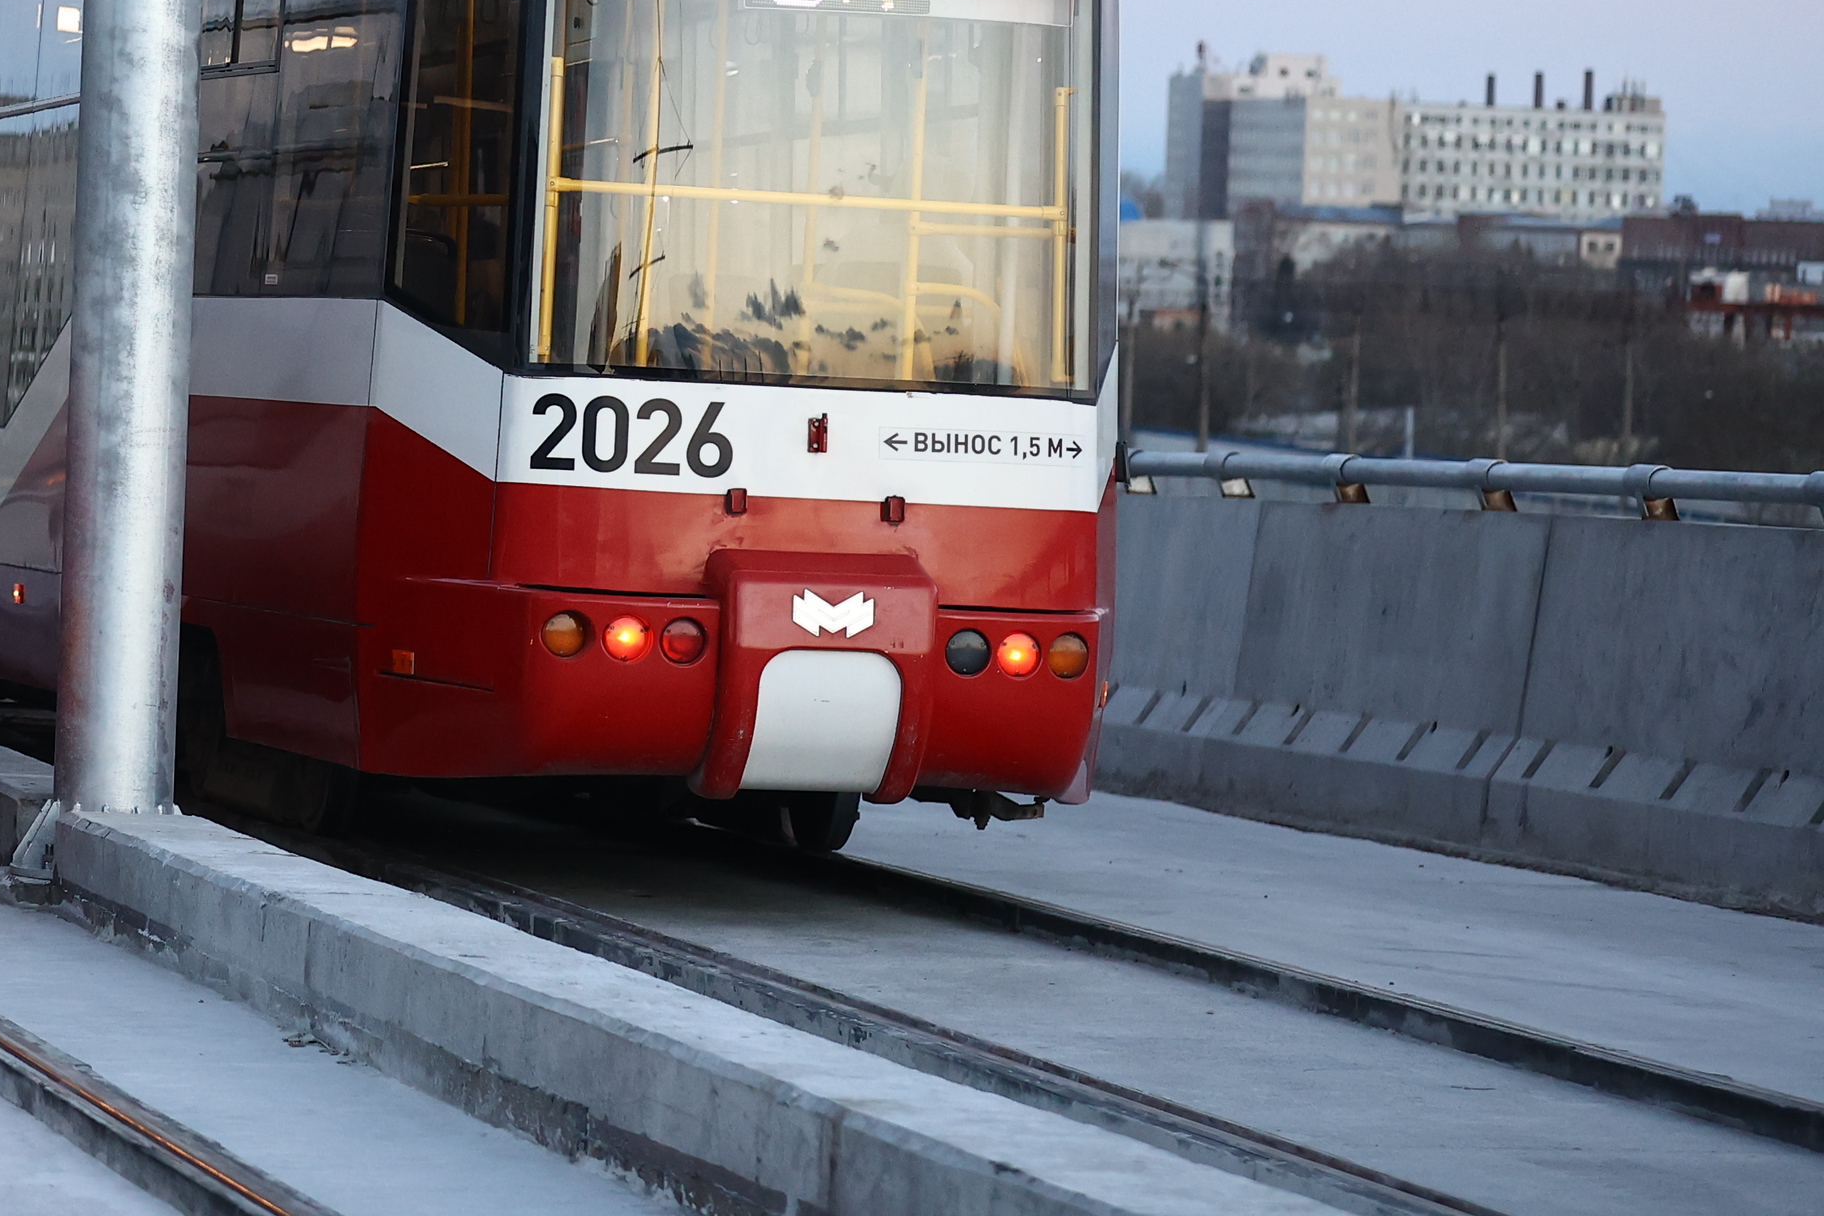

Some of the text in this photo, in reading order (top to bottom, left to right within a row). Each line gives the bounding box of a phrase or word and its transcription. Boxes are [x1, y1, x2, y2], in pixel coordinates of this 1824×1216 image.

[529, 392, 734, 478] 2026
[913, 431, 1002, 456] ВЫНОС
[1009, 435, 1042, 461] 1,5
